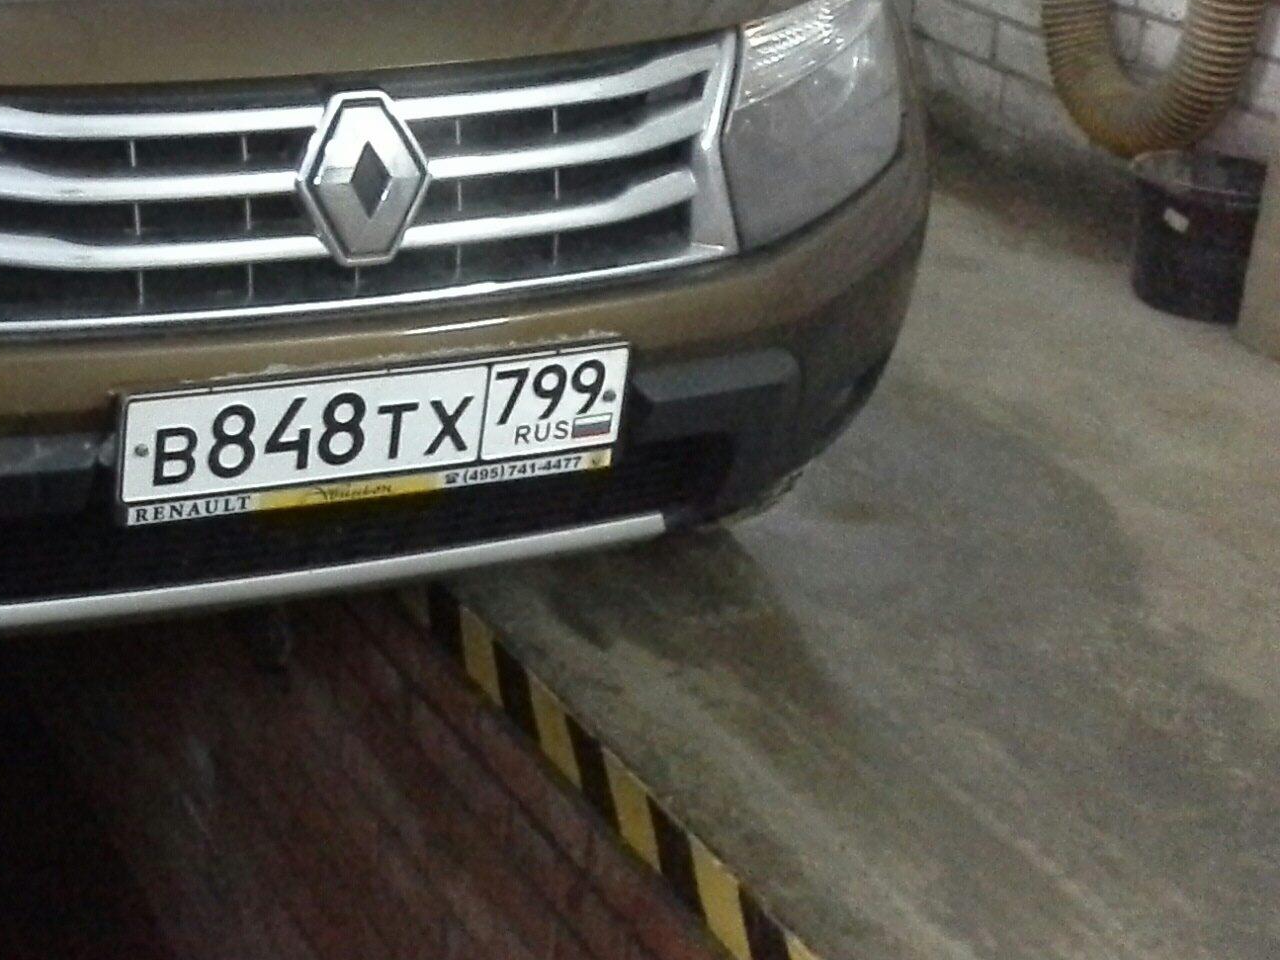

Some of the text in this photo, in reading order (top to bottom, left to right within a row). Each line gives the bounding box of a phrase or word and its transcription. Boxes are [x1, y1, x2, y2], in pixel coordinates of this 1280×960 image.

[495, 359, 606, 426] 799
[152, 391, 475, 486] В848ТХ
[514, 420, 570, 445] RUS
[135, 495, 251, 523] RENAULT
